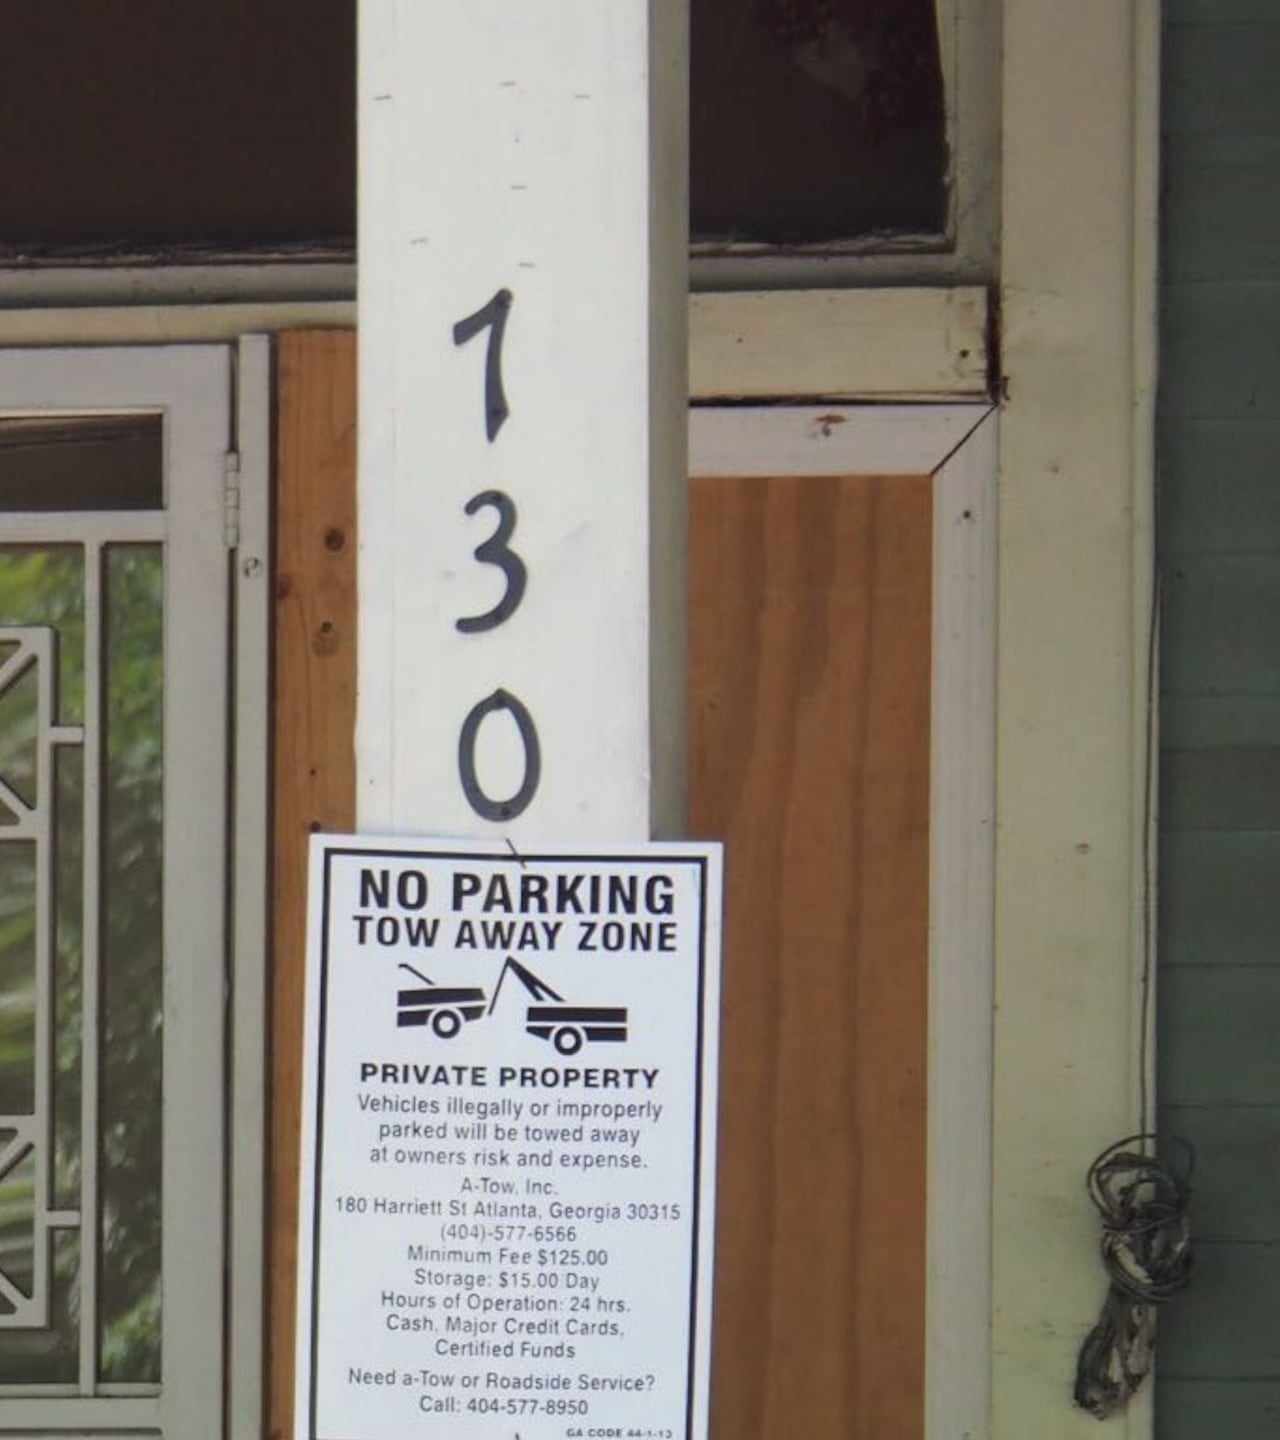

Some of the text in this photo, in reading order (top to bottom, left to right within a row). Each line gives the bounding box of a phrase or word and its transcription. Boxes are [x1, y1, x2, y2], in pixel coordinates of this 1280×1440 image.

[360, 869, 673, 915] NO PARKING
[353, 916, 676, 951] TOW AWAY ZONE
[361, 1063, 658, 1089] PRIVATE PROPERTY
[358, 1096, 662, 1122] Vehicles illegally or improperly
[379, 1123, 640, 1147] parked will be towed away
[370, 1148, 647, 1171] at owners risk and expense.
[526, 1179, 558, 1195] Inc.
[336, 1196, 367, 1213] 180
[374, 1197, 442, 1216] Harriett
[449, 1200, 467, 1217] St
[549, 1201, 620, 1223] Georgia
[627, 1203, 680, 1220] 30315
[441, 1224, 577, 1242] (404)-577-6566
[408, 1245, 608, 1266] Minimum Fee $125.00
[414, 1268, 599, 1293] Storage: $15.00 Day
[381, 1291, 630, 1314] Hours of Operation: 24 hrs.
[446, 1316, 498, 1337] Major
[504, 1317, 559, 1335] Credit
[435, 1339, 575, 1358] Certified Funds
[349, 1368, 396, 1385] Need
[461, 1375, 480, 1388] or
[486, 1372, 571, 1390] Roadside
[578, 1374, 655, 1391] Service?
[419, 1395, 588, 1415] Call: 404-577-8950
[588, 1428, 622, 1438] CODE
